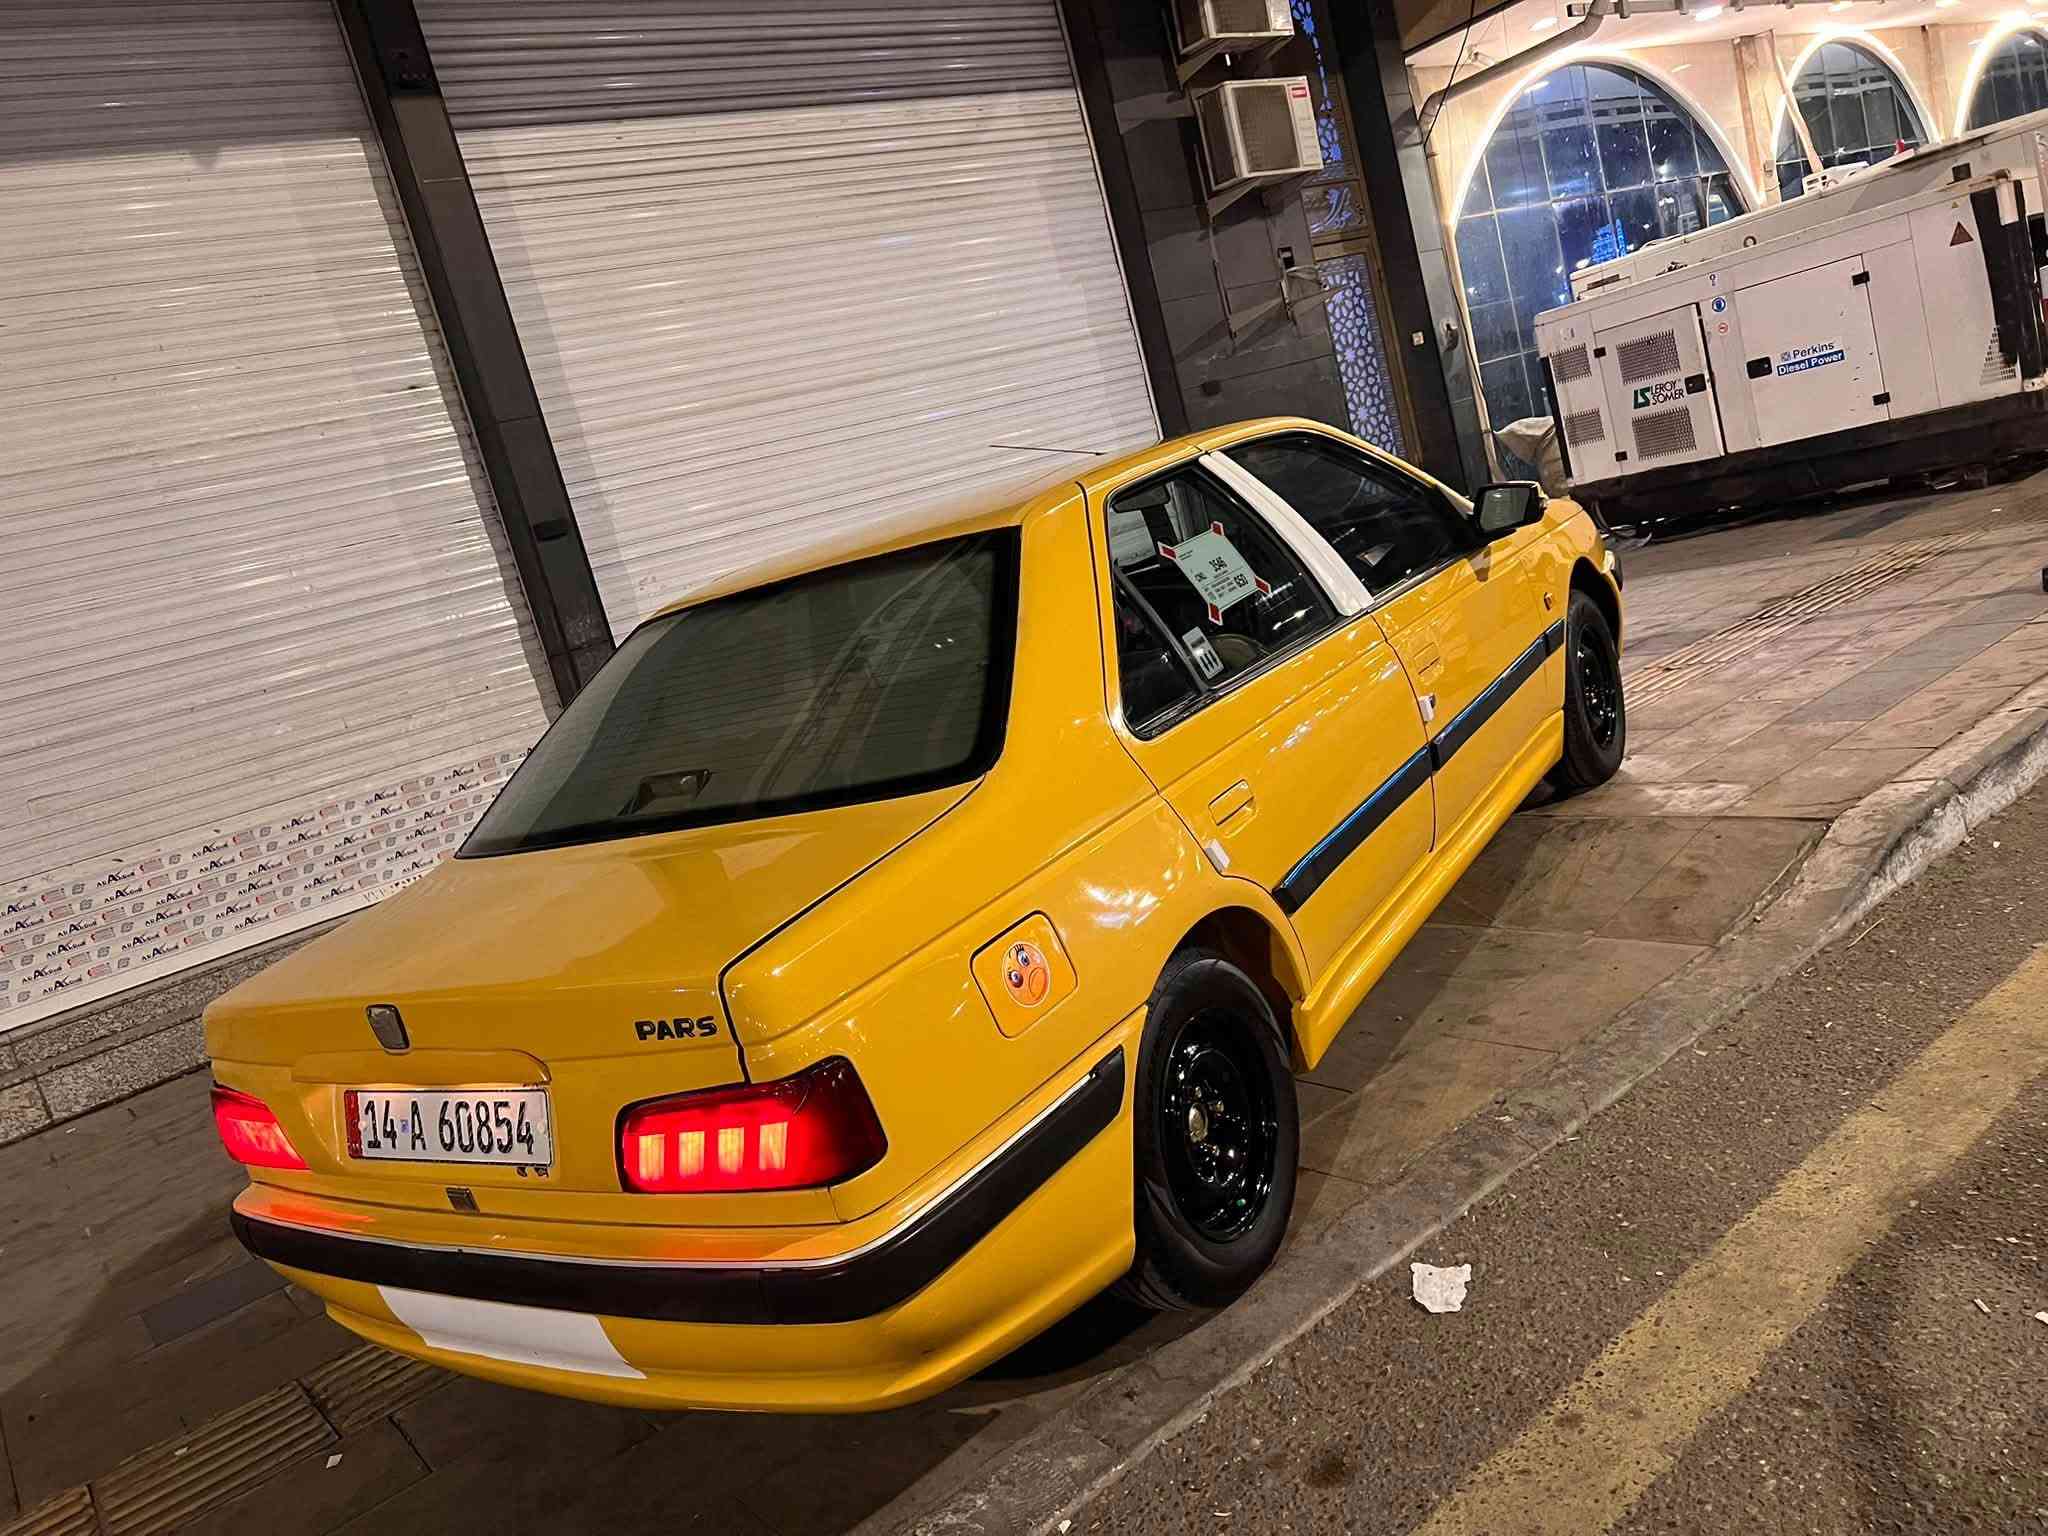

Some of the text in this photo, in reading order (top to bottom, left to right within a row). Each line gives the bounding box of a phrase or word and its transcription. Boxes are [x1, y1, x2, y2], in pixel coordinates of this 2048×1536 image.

[1793, 342, 1834, 359] Perkins
[1779, 352, 1842, 375] Diesel Power
[1651, 380, 1677, 395] LEROY
[1652, 389, 1685, 405] SOMER
[634, 1016, 717, 1041] PARS
[364, 1100, 534, 1154] 14 A 60854
